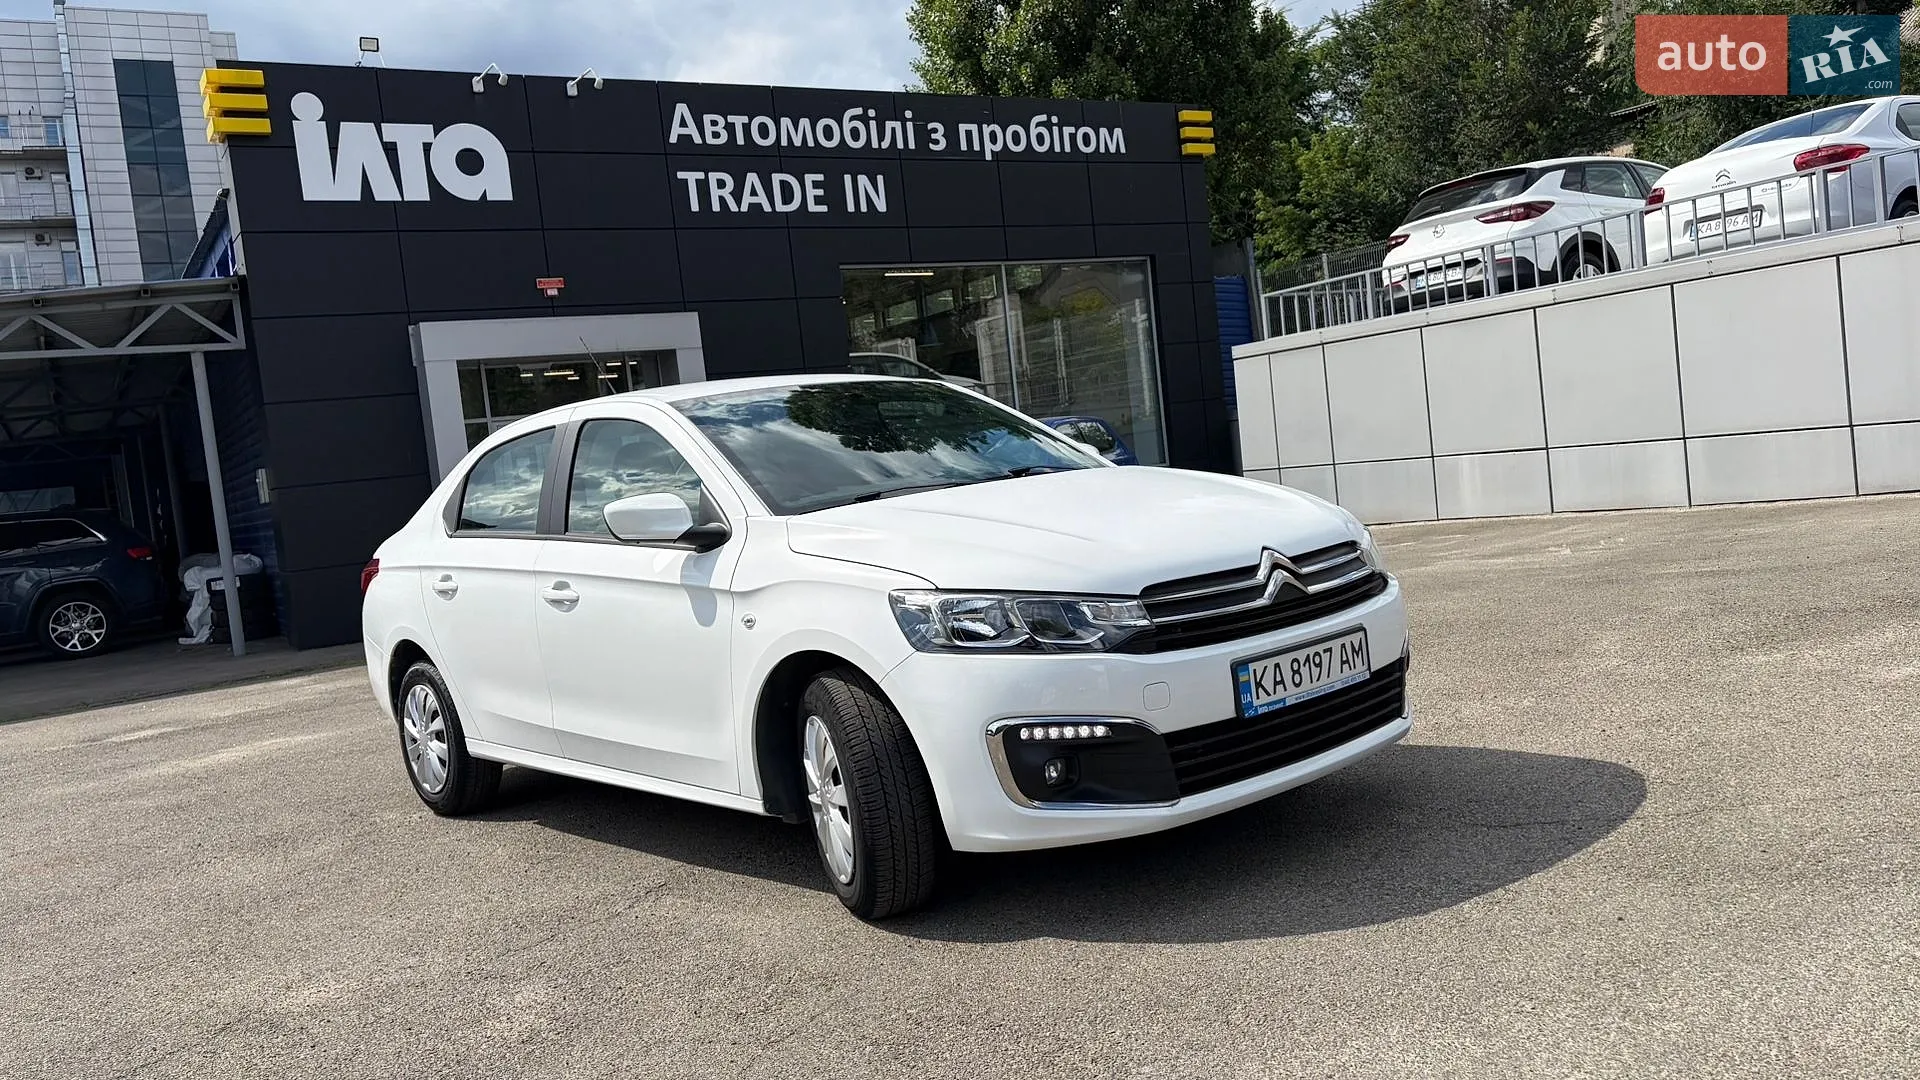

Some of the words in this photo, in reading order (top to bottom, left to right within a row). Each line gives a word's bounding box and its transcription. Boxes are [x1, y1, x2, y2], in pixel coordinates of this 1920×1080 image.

[669, 102, 916, 150] Автомобілі
[927, 121, 947, 151] з
[958, 114, 1126, 161] пробігом
[677, 171, 828, 213] TRADE
[843, 173, 887, 213] IN
[1253, 662, 1287, 700] KA
[1290, 647, 1333, 688] 8197
[1340, 637, 1365, 674] AM
[1241, 693, 1252, 704] UA
